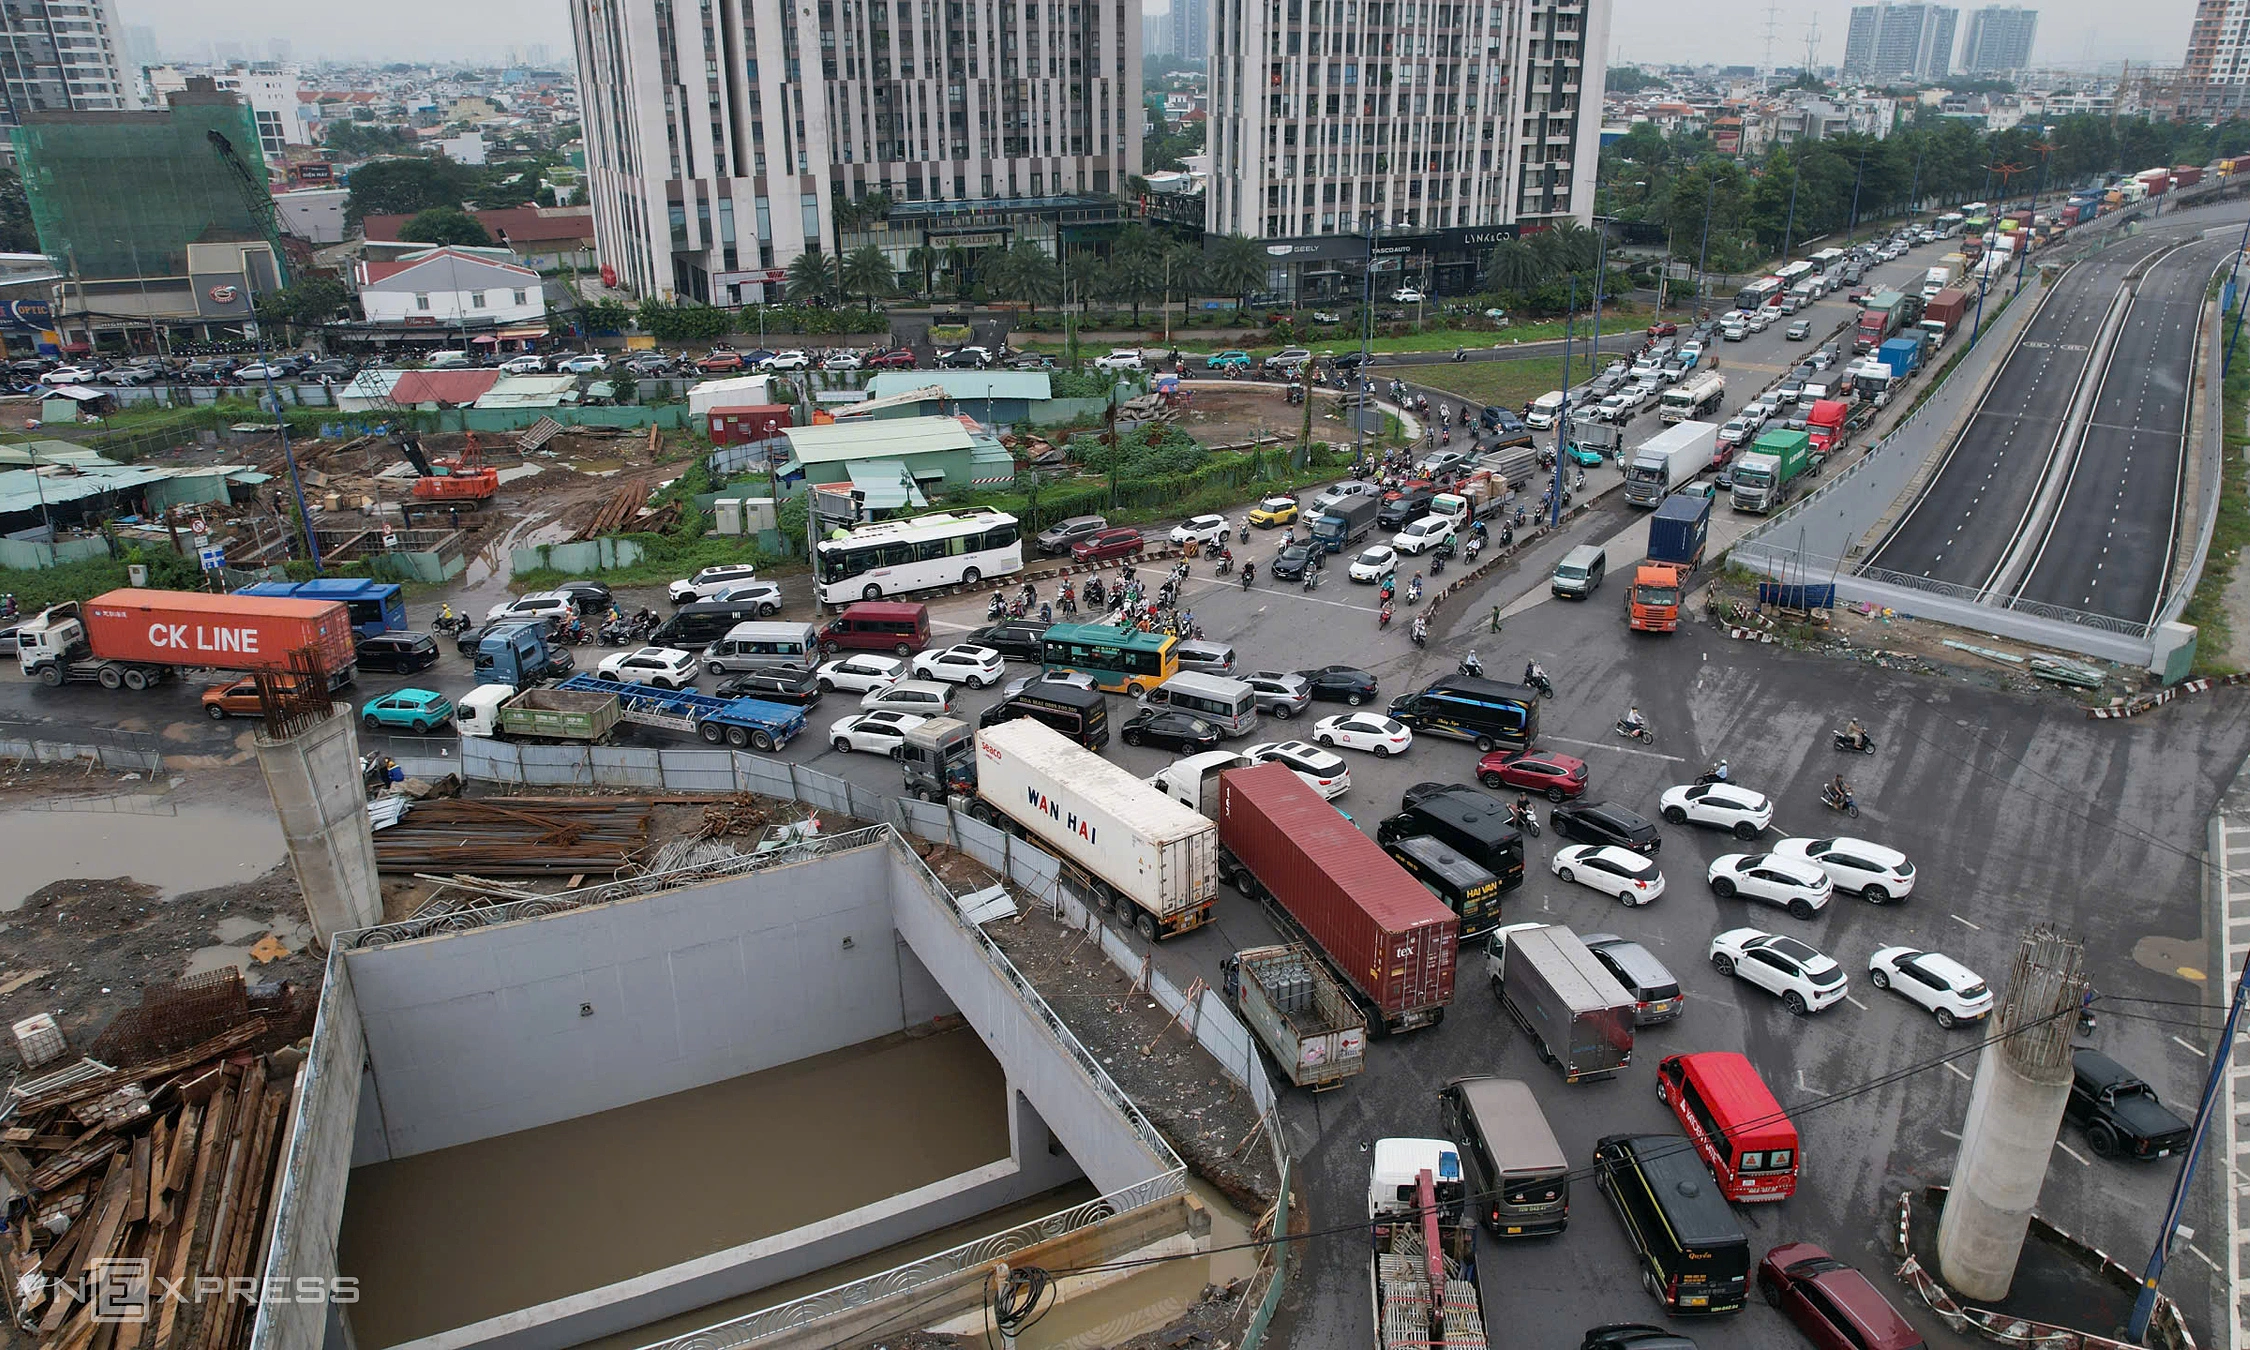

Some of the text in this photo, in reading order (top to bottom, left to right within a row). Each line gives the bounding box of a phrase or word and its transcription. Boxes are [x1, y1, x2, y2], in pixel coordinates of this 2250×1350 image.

[18, 305, 48, 315] OPTIC
[149, 623, 259, 653] CK LINE
[982, 741, 1002, 759] seaco
[1028, 786, 1096, 845] WAN HAI
[1397, 946, 1414, 958] tex
